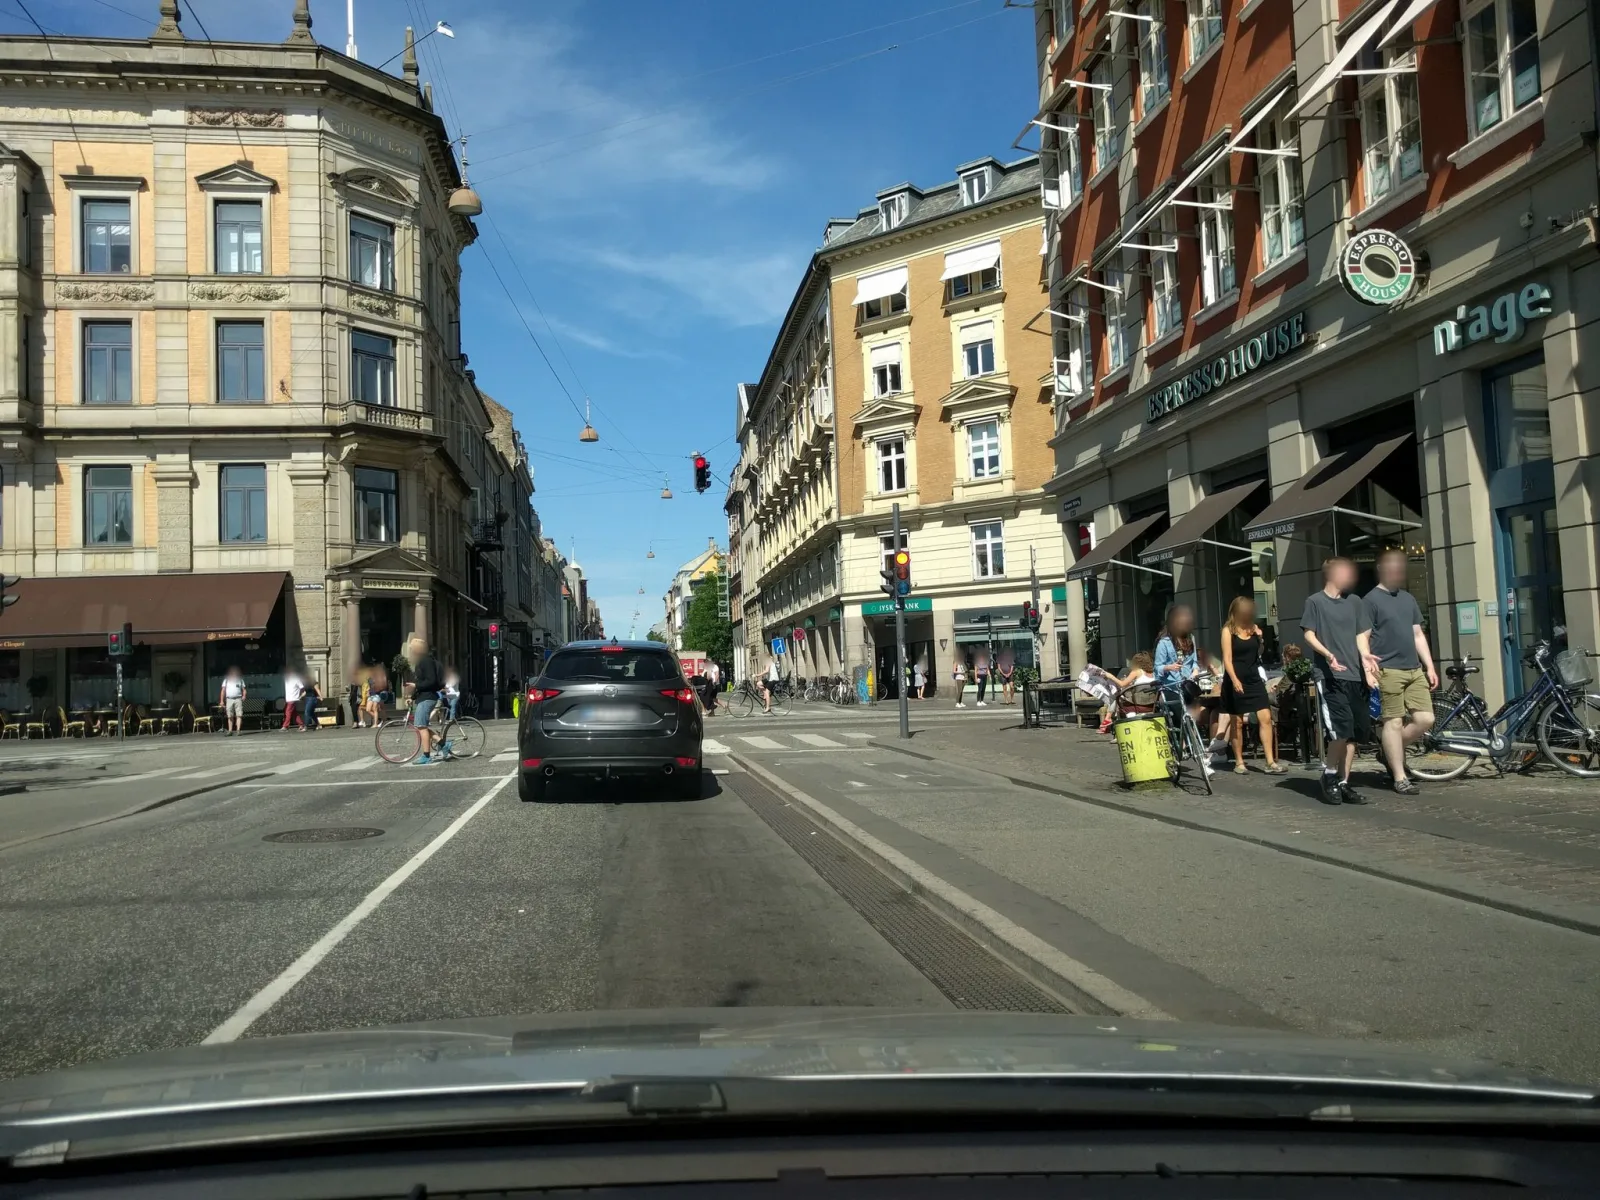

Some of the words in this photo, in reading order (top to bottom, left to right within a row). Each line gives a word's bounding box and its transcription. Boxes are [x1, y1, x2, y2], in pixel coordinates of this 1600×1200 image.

[1350, 234, 1408, 260] ESPRESSO
[1360, 281, 1405, 298] HOUSE
[1147, 357, 1228, 421] ESPRESSO
[1228, 312, 1305, 380] HOUSE
[1248, 528, 1274, 540] ESPRESSO
[1275, 522, 1295, 535] HOUSE
[1160, 551, 1174, 560] HOUSE
[364, 580, 392, 588] BISTRO
[394, 581, 418, 589] ROYAL
